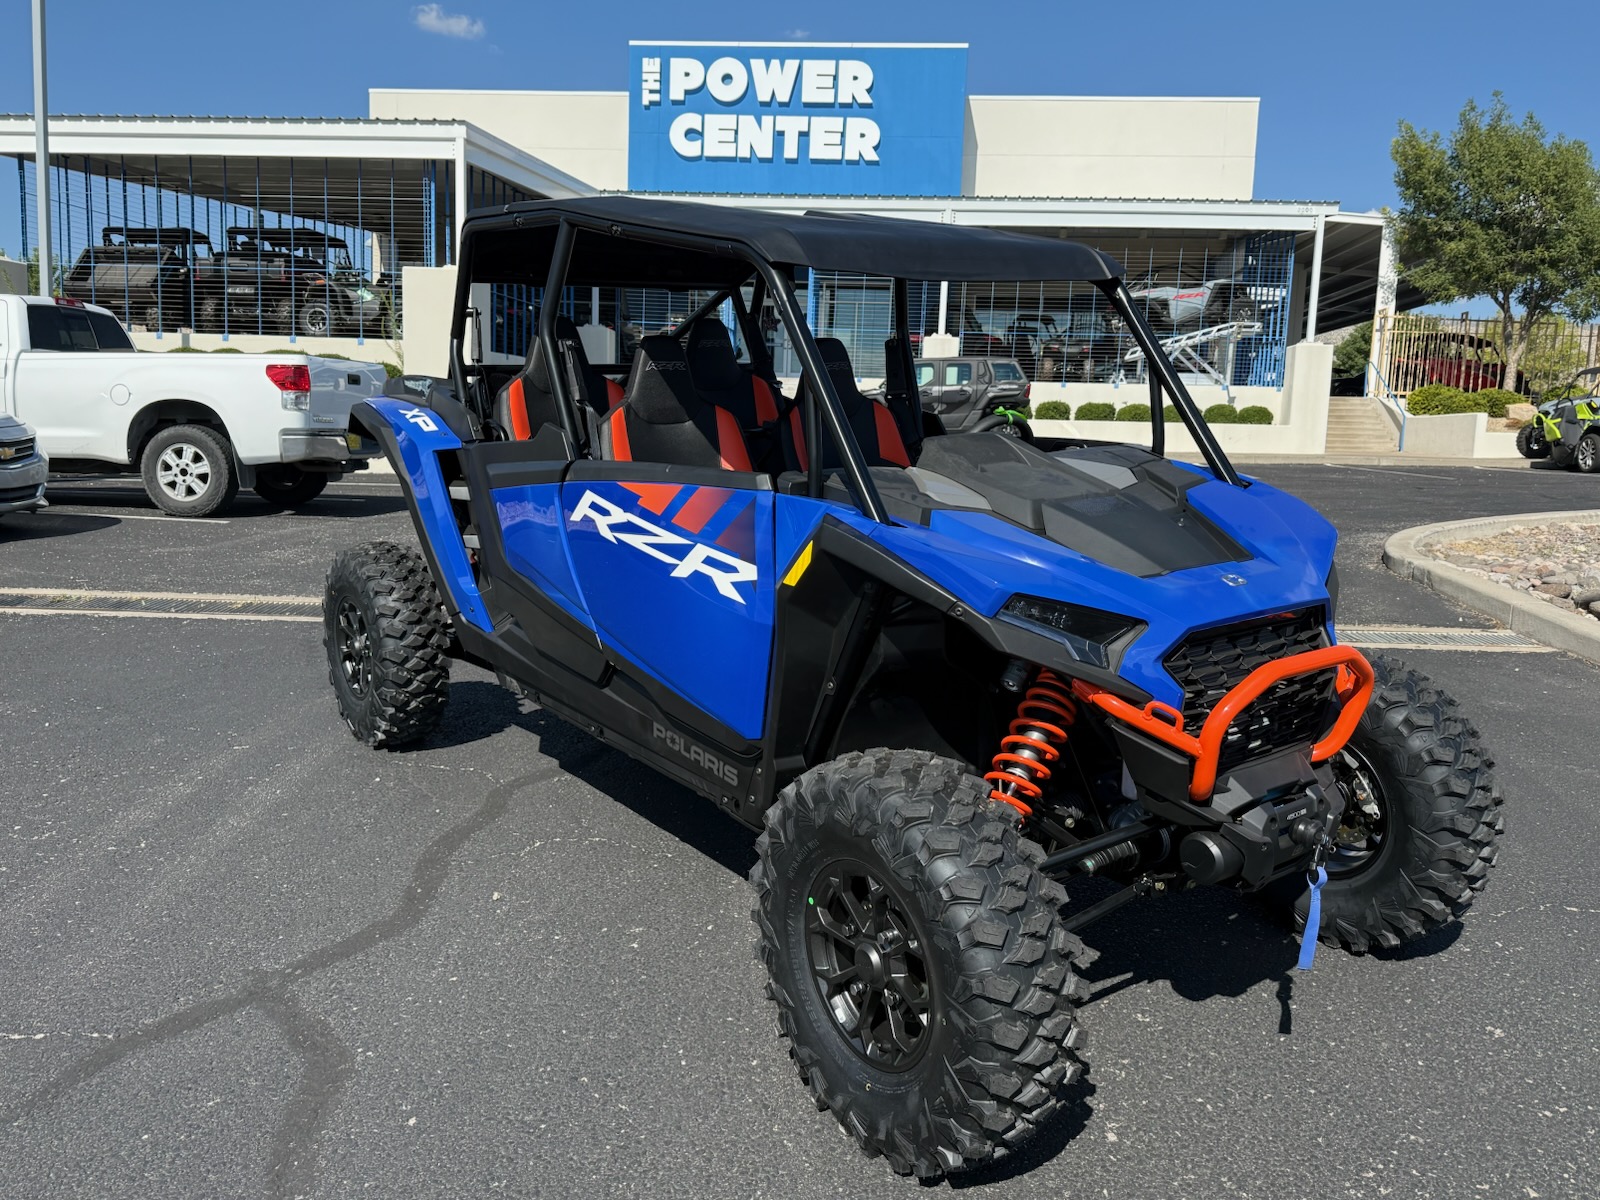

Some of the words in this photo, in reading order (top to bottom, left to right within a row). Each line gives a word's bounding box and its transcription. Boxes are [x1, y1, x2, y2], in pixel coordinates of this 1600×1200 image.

[641, 57, 661, 108] THE
[669, 56, 874, 106] POWER
[668, 112, 881, 164] CENTER
[645, 360, 687, 371] RZR
[398, 407, 439, 432] XP
[569, 488, 758, 605] RZR
[652, 720, 739, 787] POLARIS
